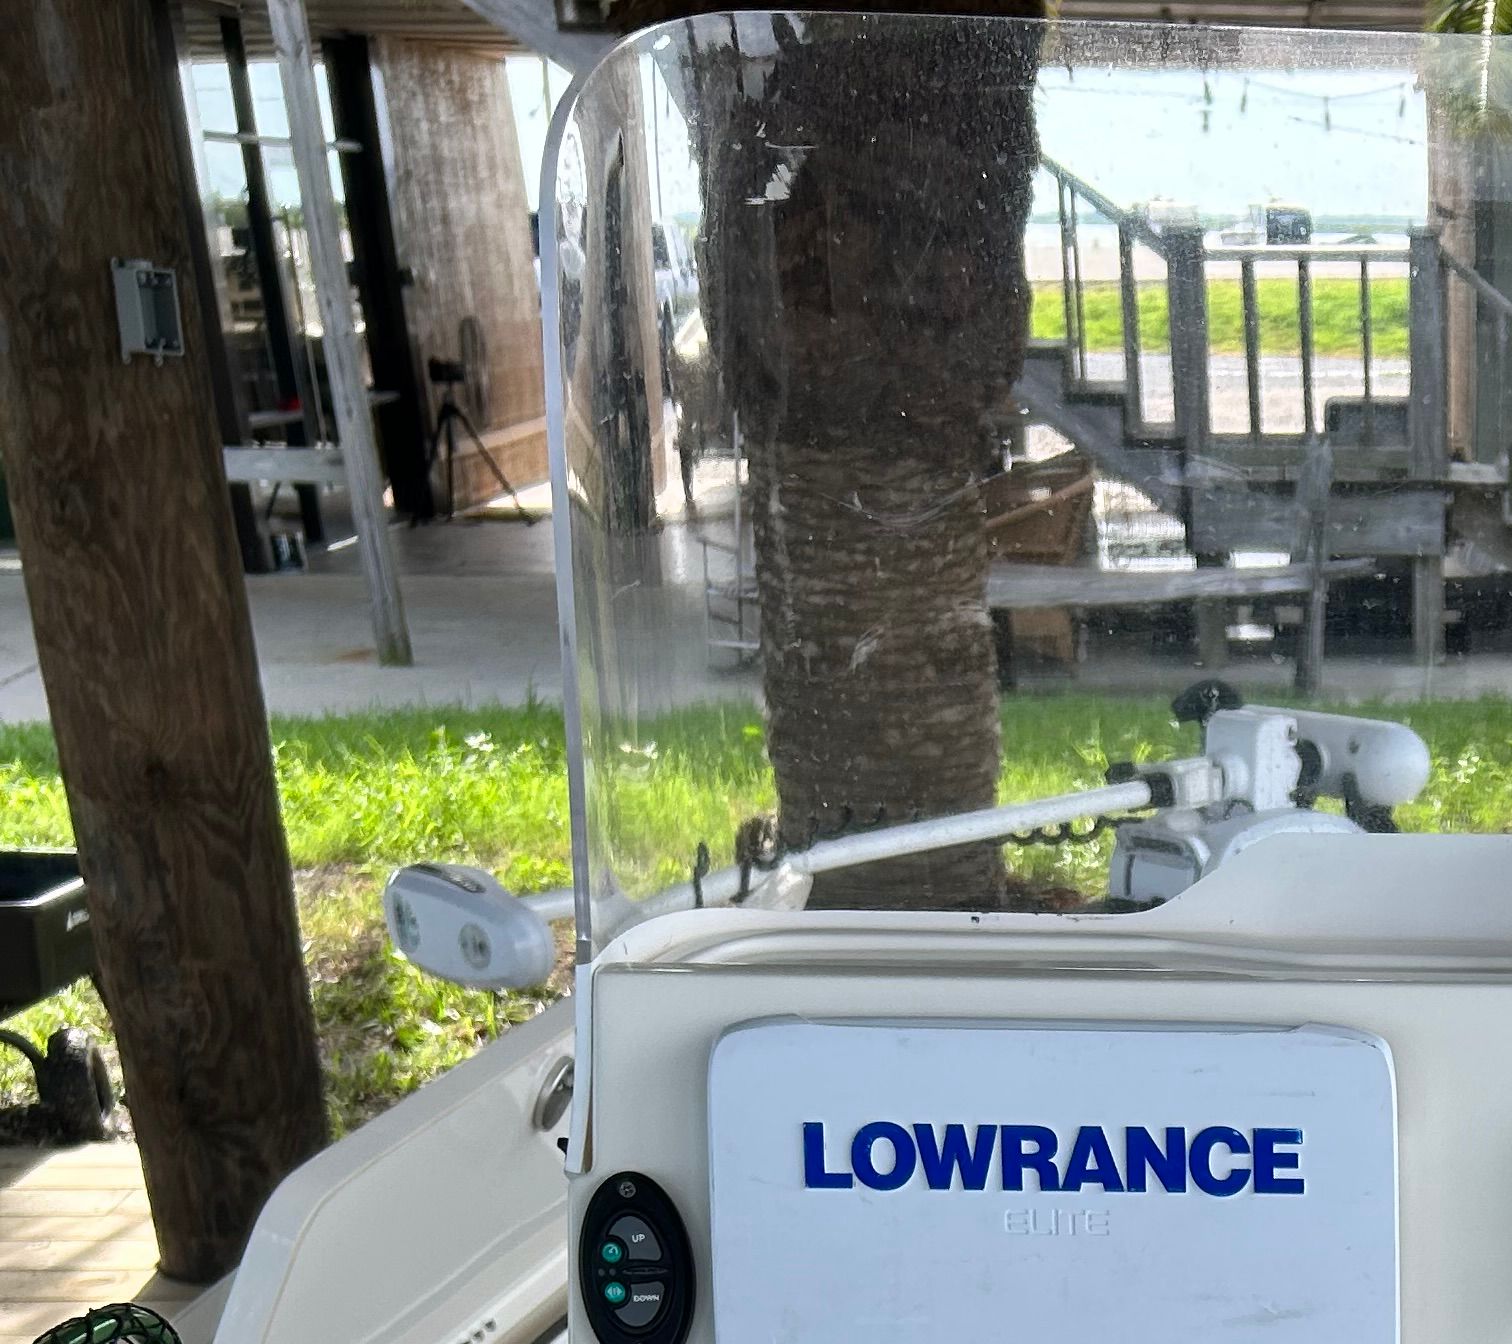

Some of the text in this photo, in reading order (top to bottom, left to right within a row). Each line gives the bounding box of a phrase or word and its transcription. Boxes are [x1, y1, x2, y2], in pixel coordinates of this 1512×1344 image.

[802, 1122, 1305, 1197] LOWRANCE
[1004, 1208, 1111, 1236] ELITE
[631, 1233, 645, 1243] UP
[633, 1294, 660, 1303] DOWN
